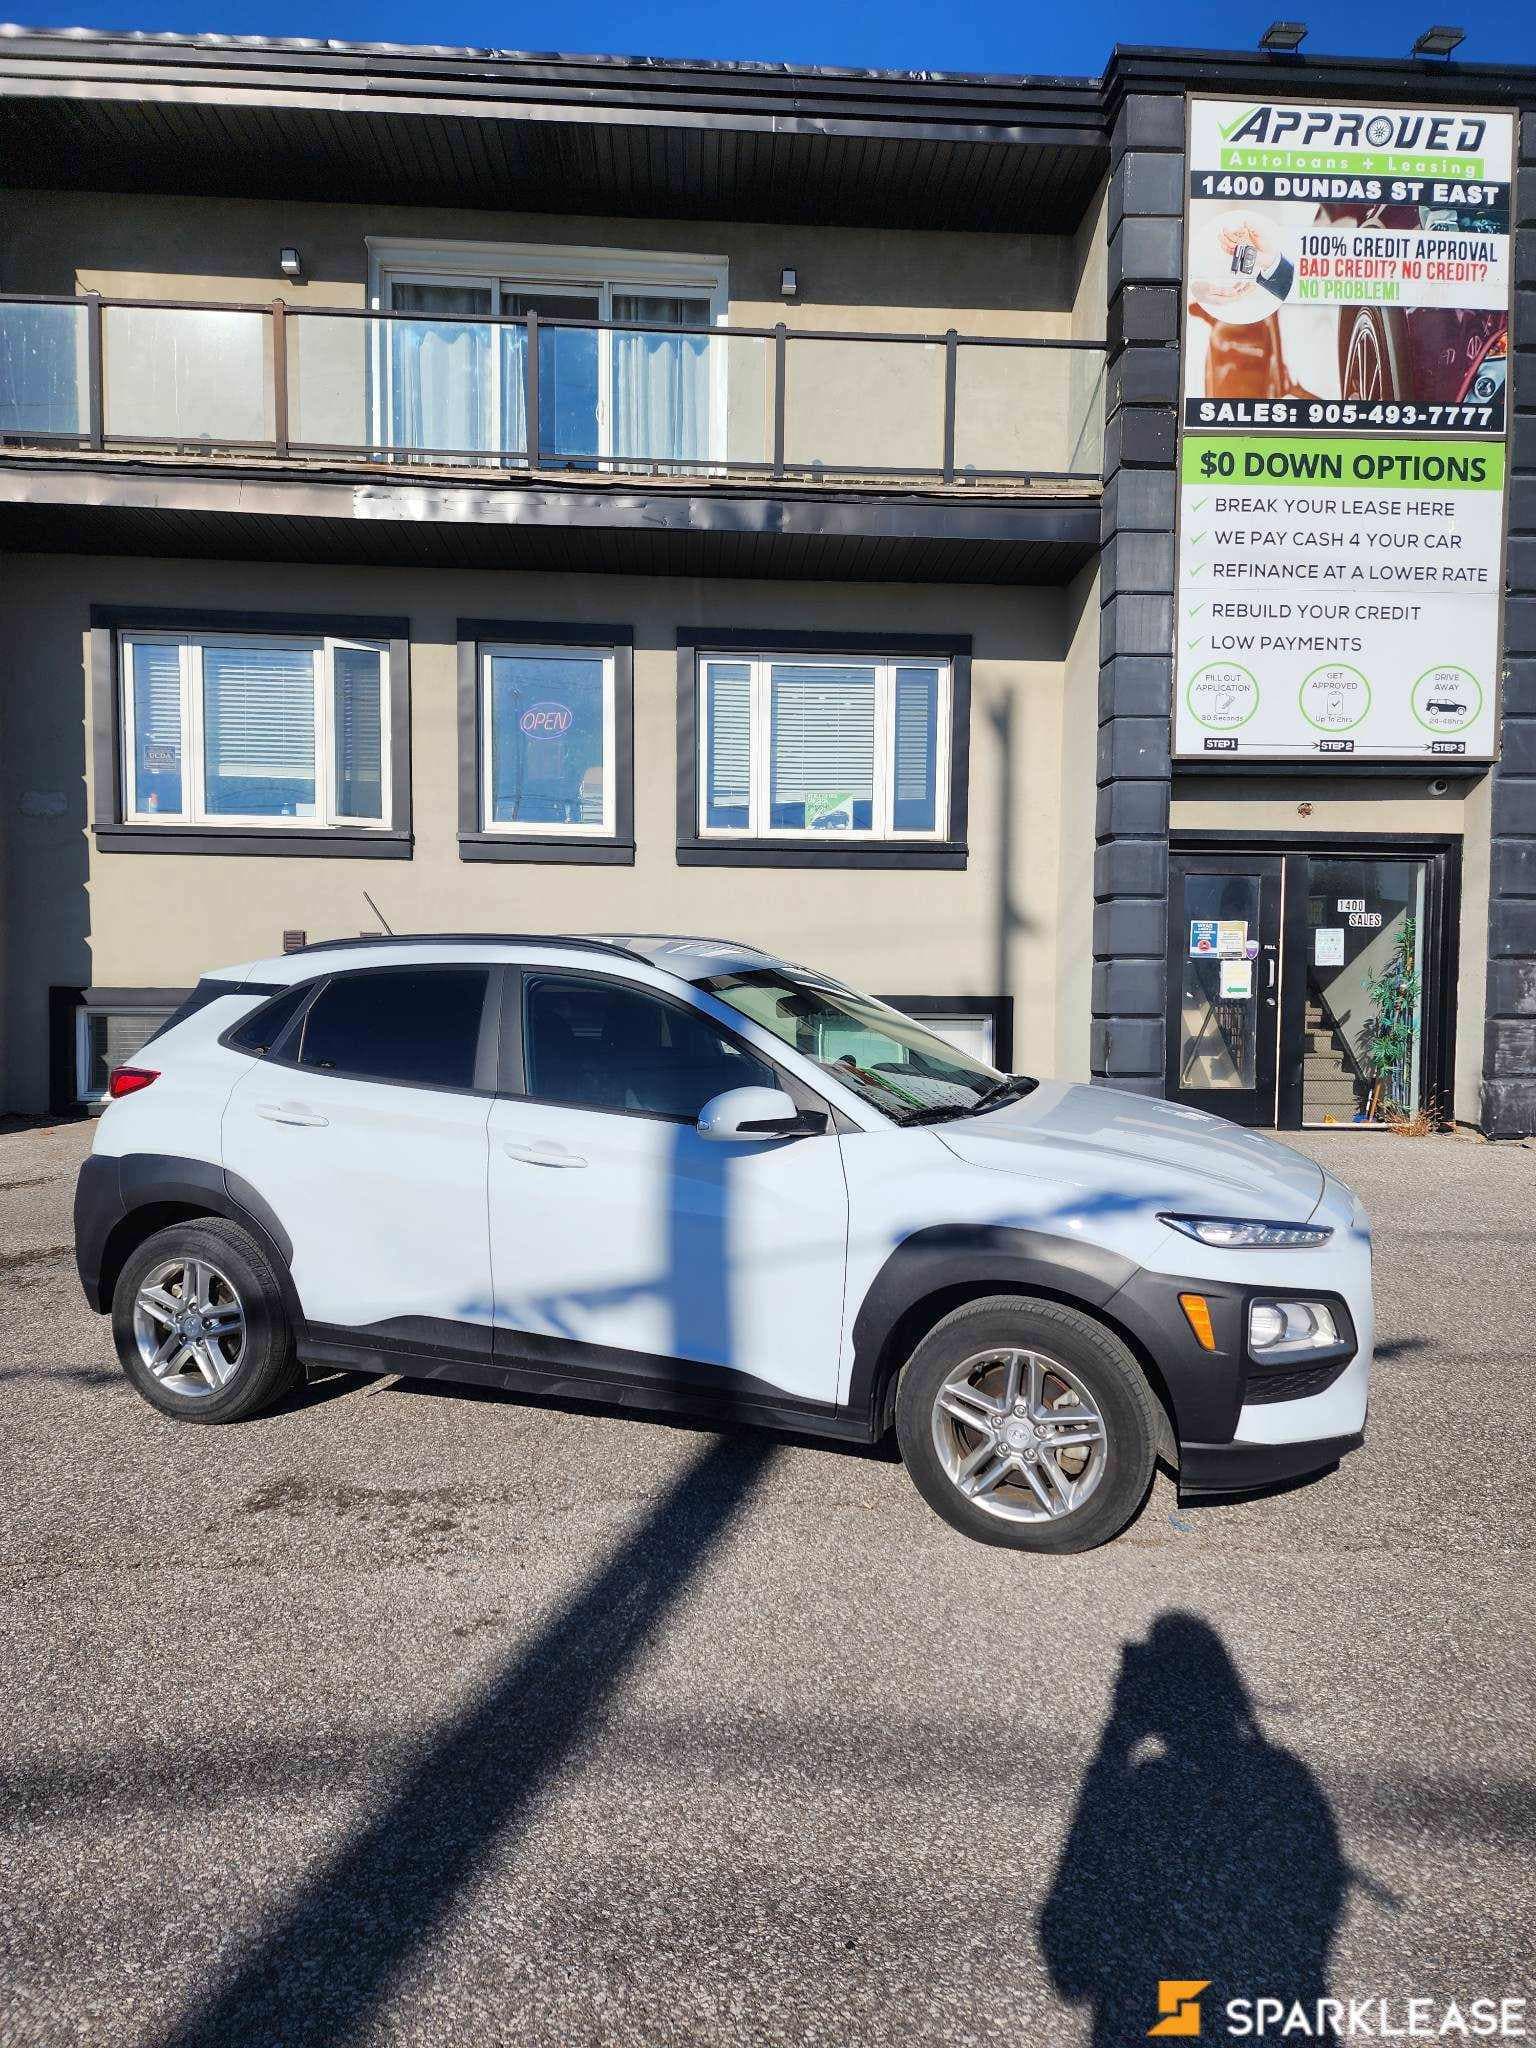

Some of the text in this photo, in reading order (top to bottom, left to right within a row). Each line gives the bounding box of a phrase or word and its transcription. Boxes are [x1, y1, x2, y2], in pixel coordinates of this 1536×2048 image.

[1230, 107, 1487, 152] APPROVED
[1229, 152, 1349, 169] Autoloans
[1388, 157, 1476, 178] Leasing
[1202, 175, 1499, 205] 1400 DUNDAS ST EAST
[1300, 235, 1498, 263] 100% CREDIT APPROVAL
[1300, 258, 1488, 283] BAD CREDIT? NO CREDIT?
[1299, 280, 1400, 301] NO PROBLEM!
[1200, 402, 1493, 426] SALES: 905-493-7777
[1200, 450, 1487, 483] $0 DOWN OPTIONS
[1215, 498, 1456, 517] BREAK YOUR LEASE HERE
[1215, 531, 1463, 549] WE PAY CASH 4 YOUR CAR
[1213, 563, 1488, 582] REFINANCE AT A LOWER RATE
[1212, 603, 1421, 621] REBUILD YOUR CREDIT
[1211, 635, 1362, 652] LOW PAYMENTS
[1205, 674, 1241, 682] FILL OUT
[1326, 672, 1344, 680] GET
[1434, 673, 1459, 681] DRIVE
[1196, 684, 1250, 692] APPLICATION
[1312, 682, 1358, 690] APPROVED
[1434, 683, 1459, 691] AWAY
[523, 711, 568, 731] OPEN
[1206, 739, 1231, 749] STEP
[1320, 741, 1354, 751] STEP 2
[1432, 743, 1465, 753] STEP 3
[1338, 900, 1364, 912] 1400
[1349, 913, 1381, 926] SALES
